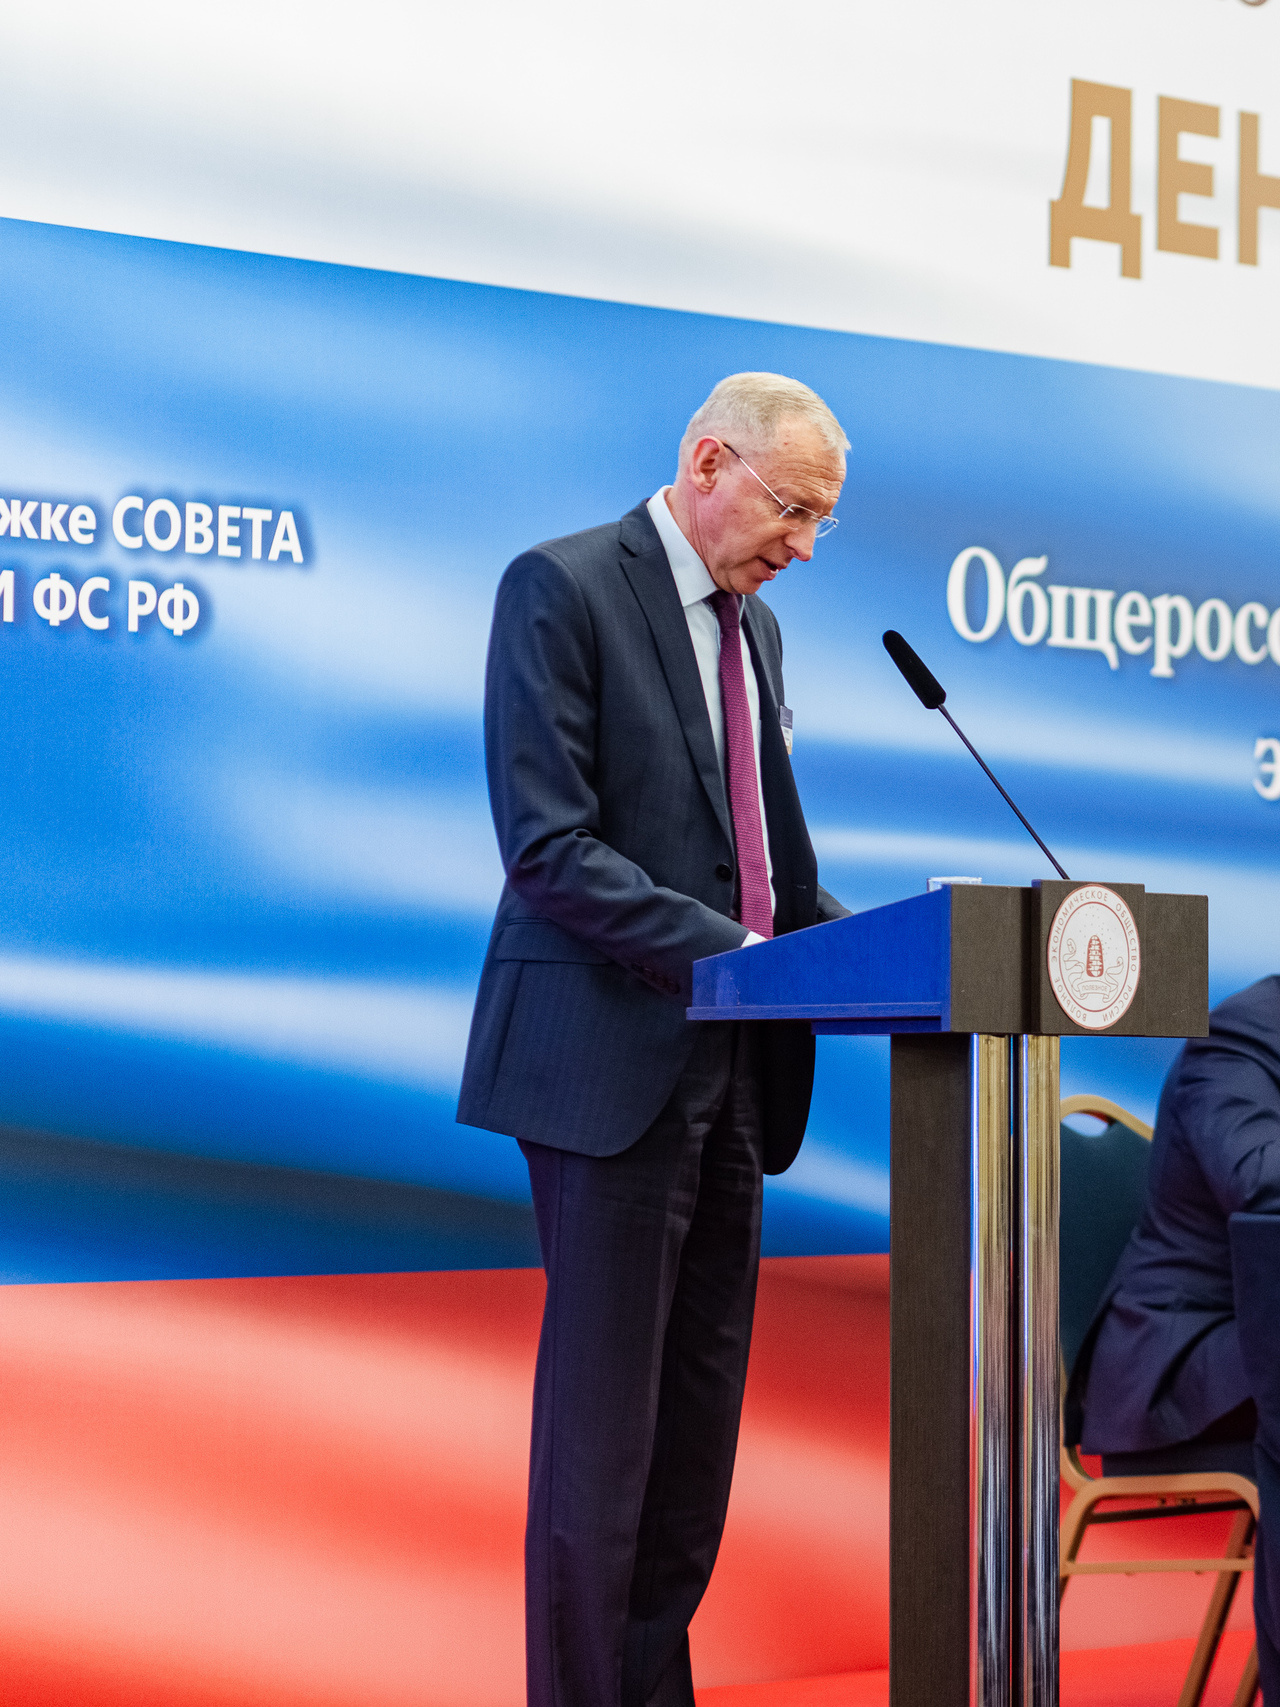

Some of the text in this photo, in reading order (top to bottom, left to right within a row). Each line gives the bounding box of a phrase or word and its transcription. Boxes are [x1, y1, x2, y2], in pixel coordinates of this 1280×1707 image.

[112, 495, 304, 563] СОВЕТА
[32, 572, 110, 631] ФС
[128, 580, 200, 637] РФ
[1051, 890, 1138, 1022] ВОЛЬНОЕ ЭКОНОМИЧЕСКОЕ ОБЩЕСТВО РОССИИ
